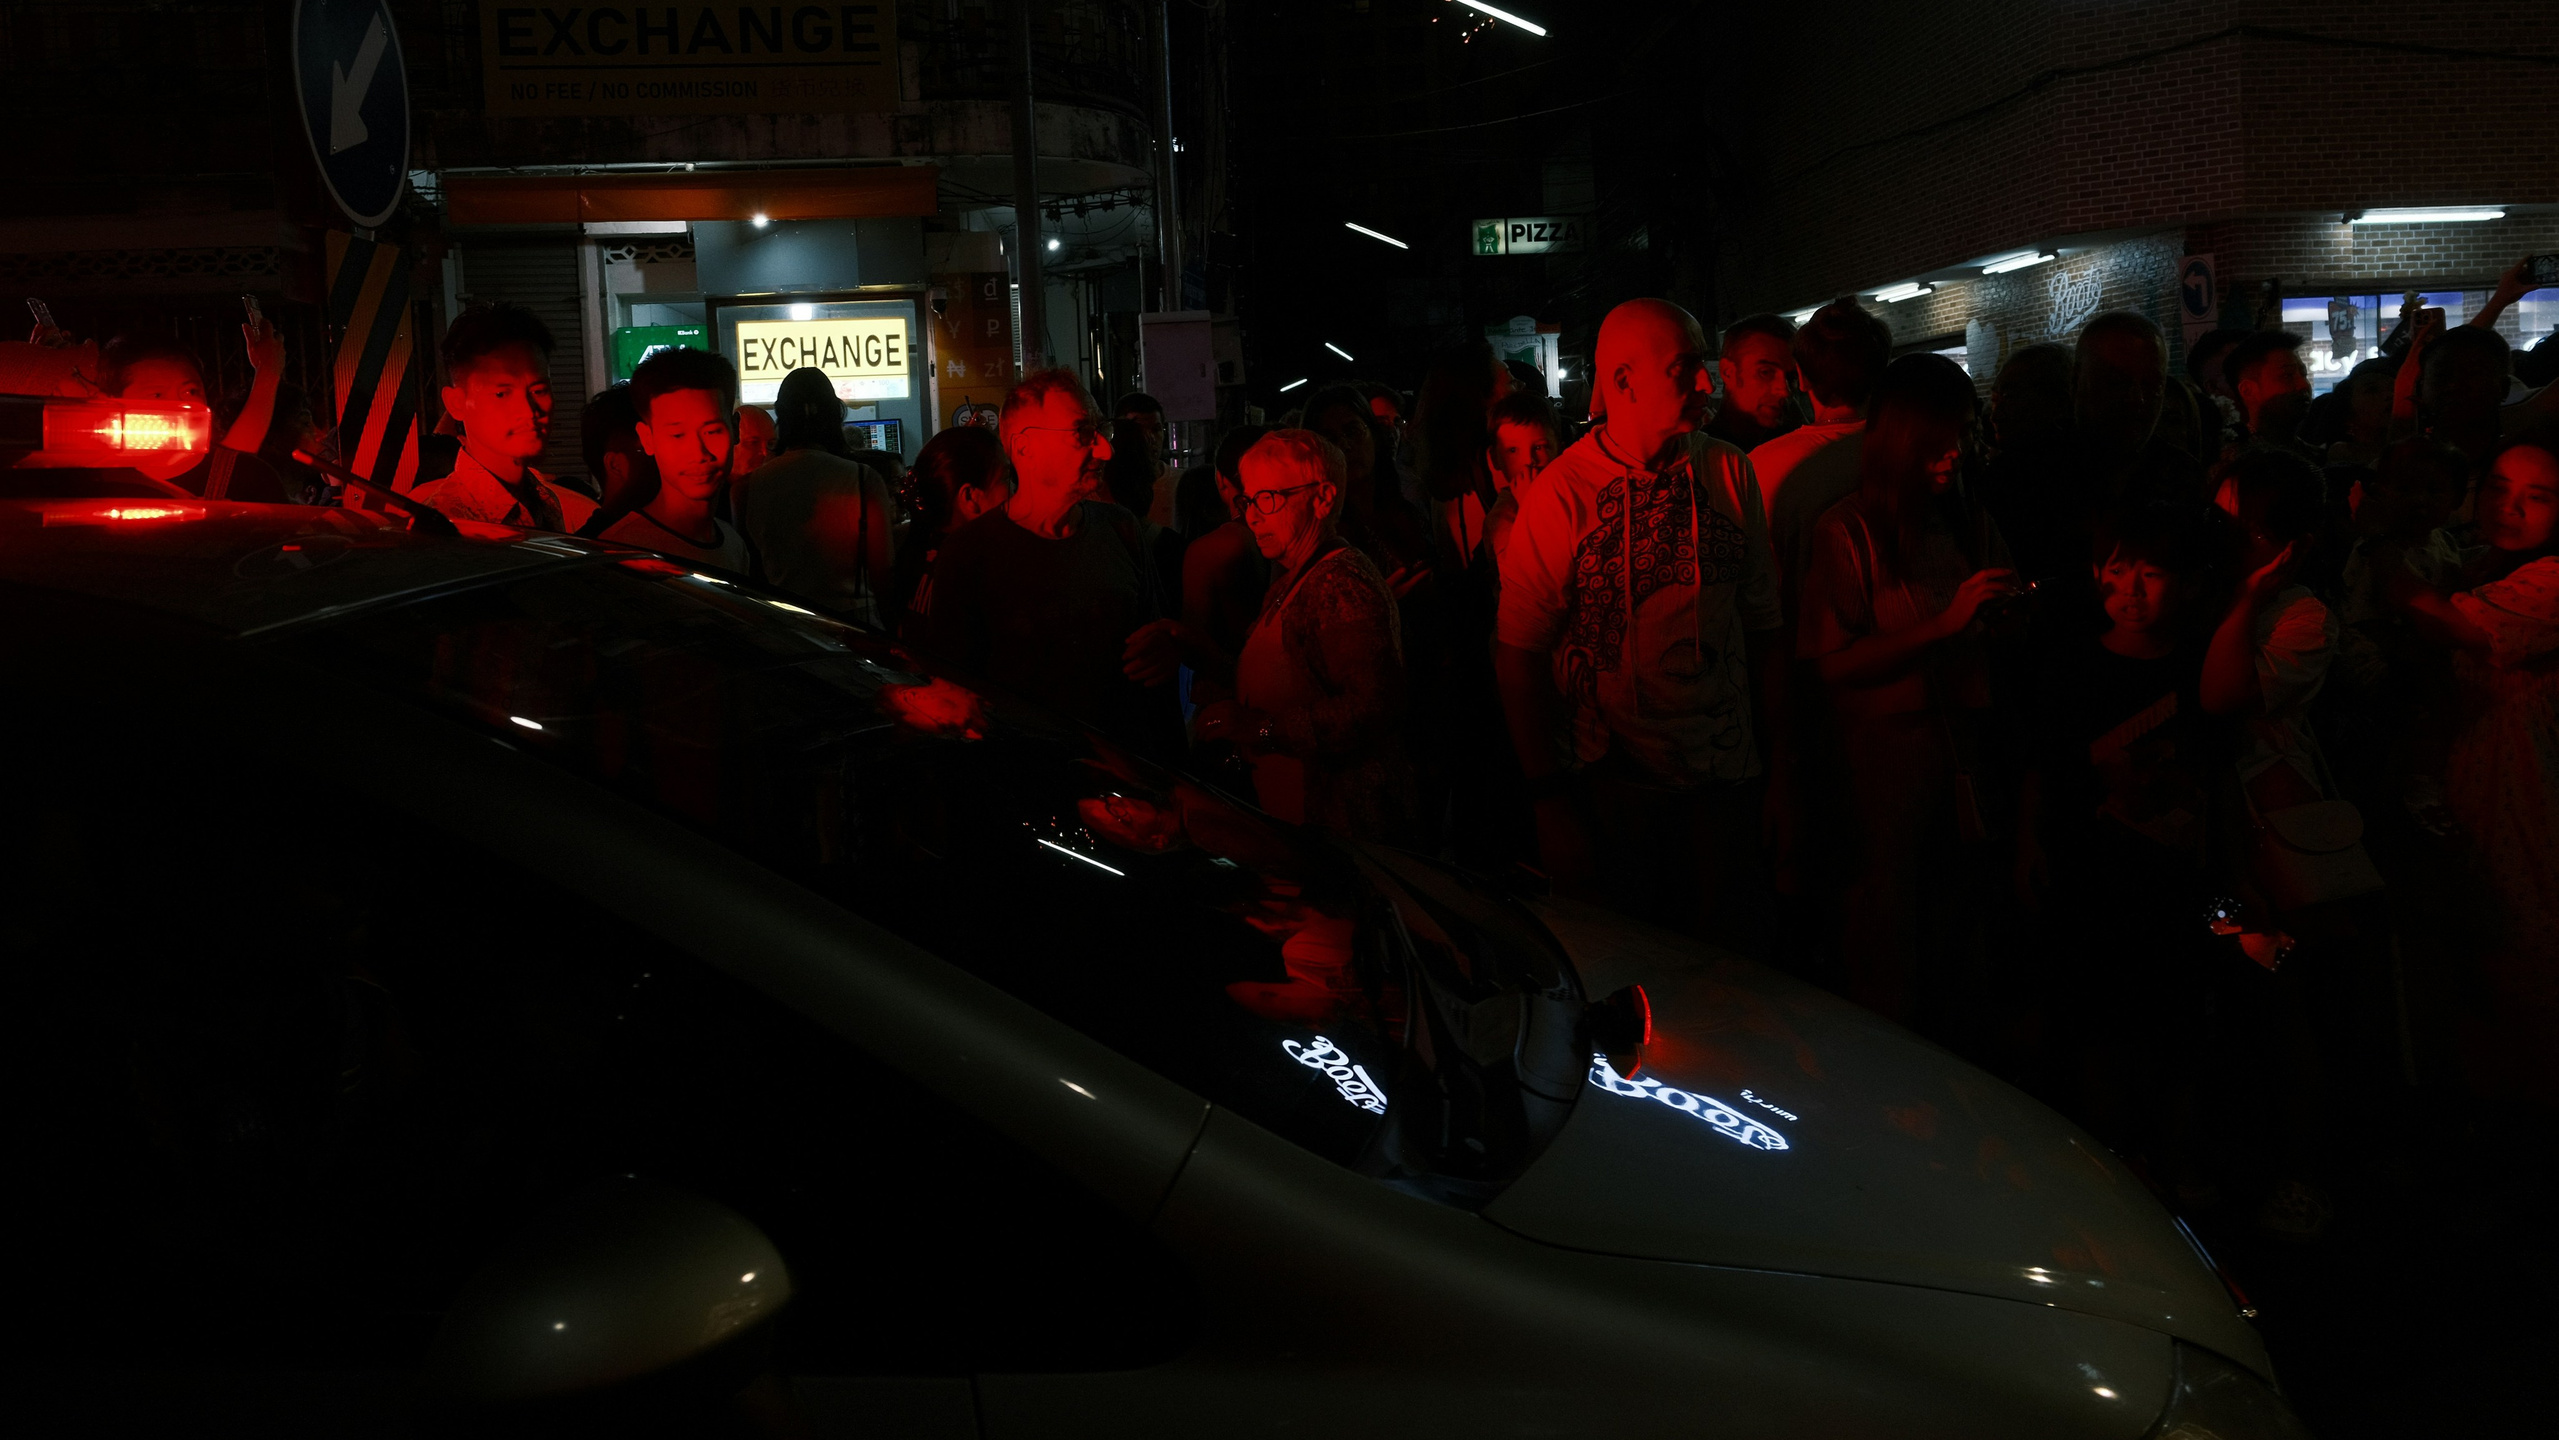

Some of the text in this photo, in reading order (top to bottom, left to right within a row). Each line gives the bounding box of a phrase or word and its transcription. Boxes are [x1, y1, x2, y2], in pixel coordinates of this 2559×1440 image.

[497, 5, 881, 56] EXCHANGE
[511, 82, 538, 101] NO
[546, 82, 582, 100] FEE
[602, 82, 629, 100] NO
[636, 80, 758, 99] COMMISSION
[1511, 222, 1580, 243] PIZZA
[743, 333, 902, 372] EXCHANGE
